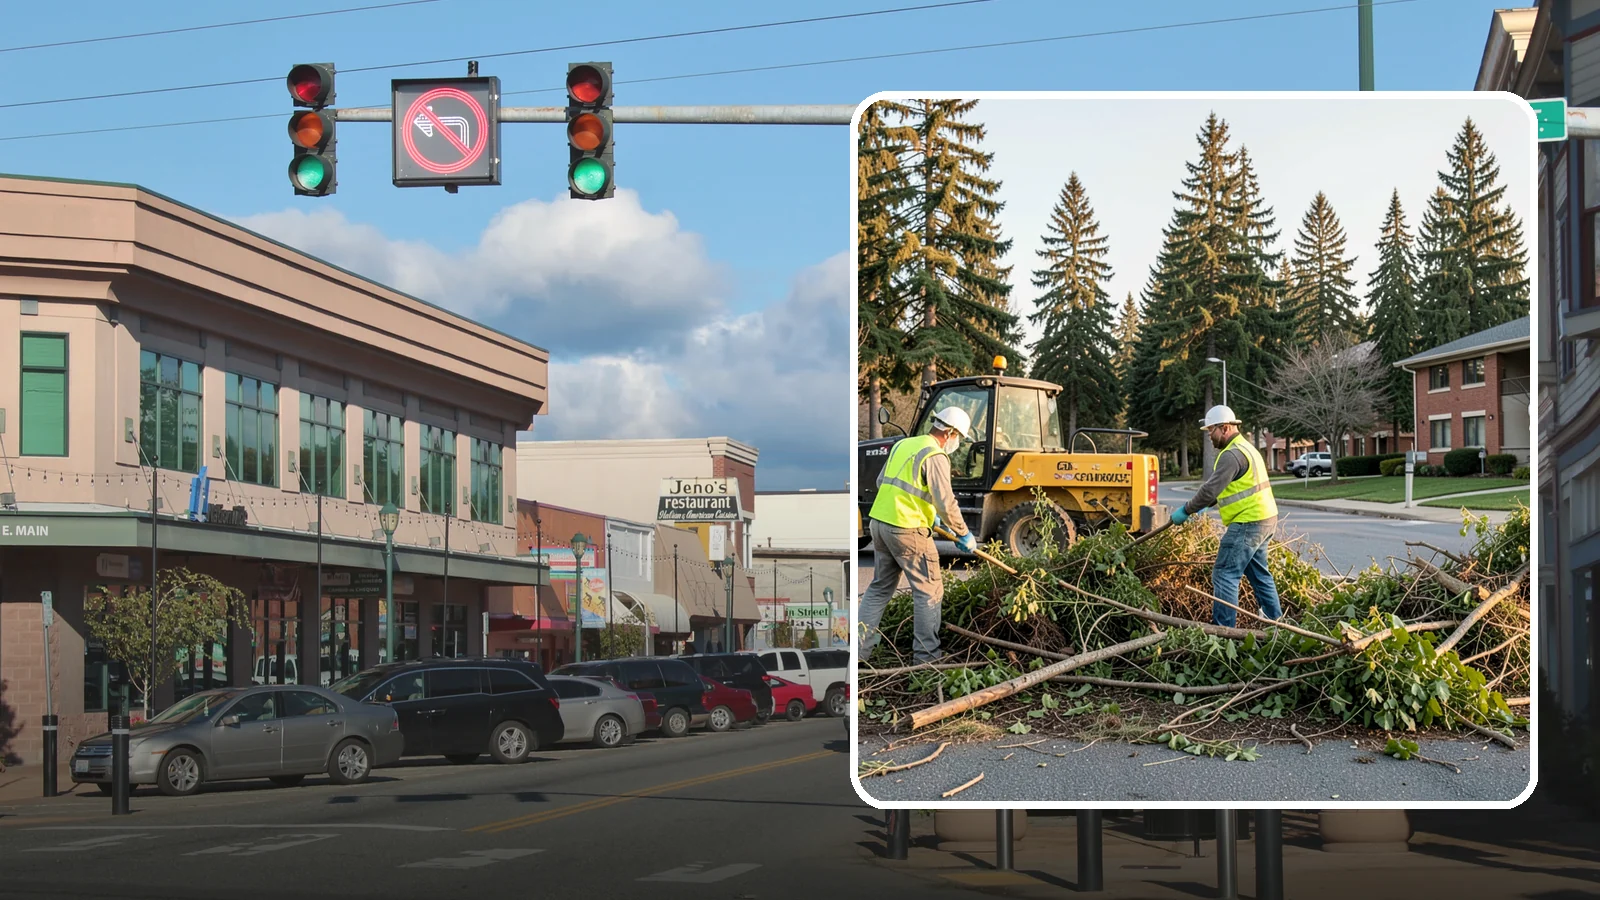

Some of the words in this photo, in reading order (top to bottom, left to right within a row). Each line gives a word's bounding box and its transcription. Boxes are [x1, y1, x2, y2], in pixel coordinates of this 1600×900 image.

[669, 480, 727, 494] Jeno's
[665, 496, 731, 509] restaurant
[658, 510, 682, 520] Italian
[686, 510, 715, 519] American
[715, 509, 737, 519] Cuisine
[2, 525, 13, 536] E.
[15, 525, 49, 536] MAIN
[797, 607, 828, 617] Street
